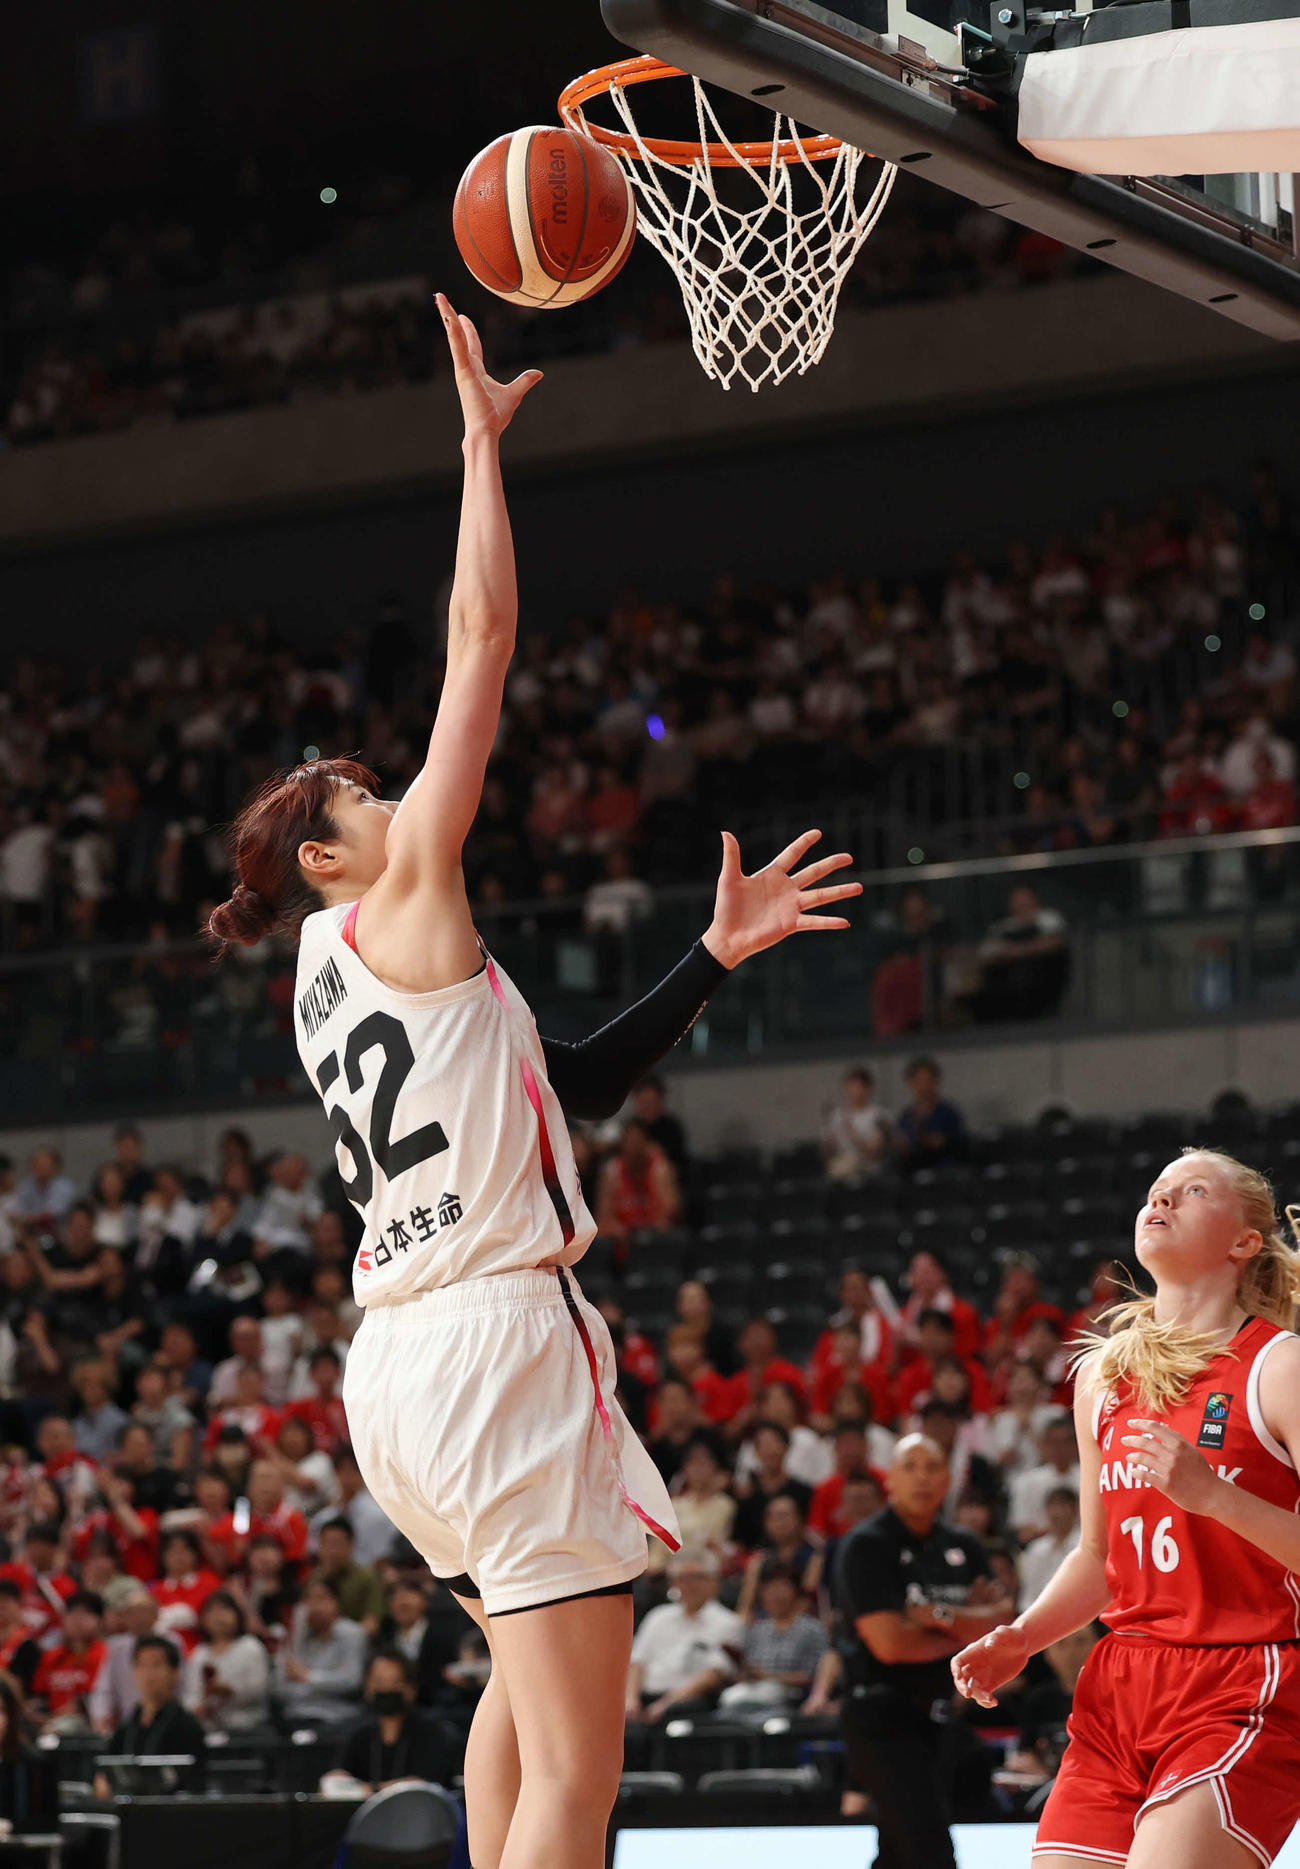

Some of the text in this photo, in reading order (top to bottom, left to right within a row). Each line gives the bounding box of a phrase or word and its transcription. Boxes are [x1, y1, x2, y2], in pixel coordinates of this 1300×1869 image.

[549, 149, 568, 225] molten
[299, 955, 348, 1043] MIYAZAWA
[316, 1010, 449, 1208] 52
[374, 1192, 464, 1267] 日本生命
[1203, 1423, 1222, 1435] FIBA
[1120, 1516, 1180, 1573] 16
